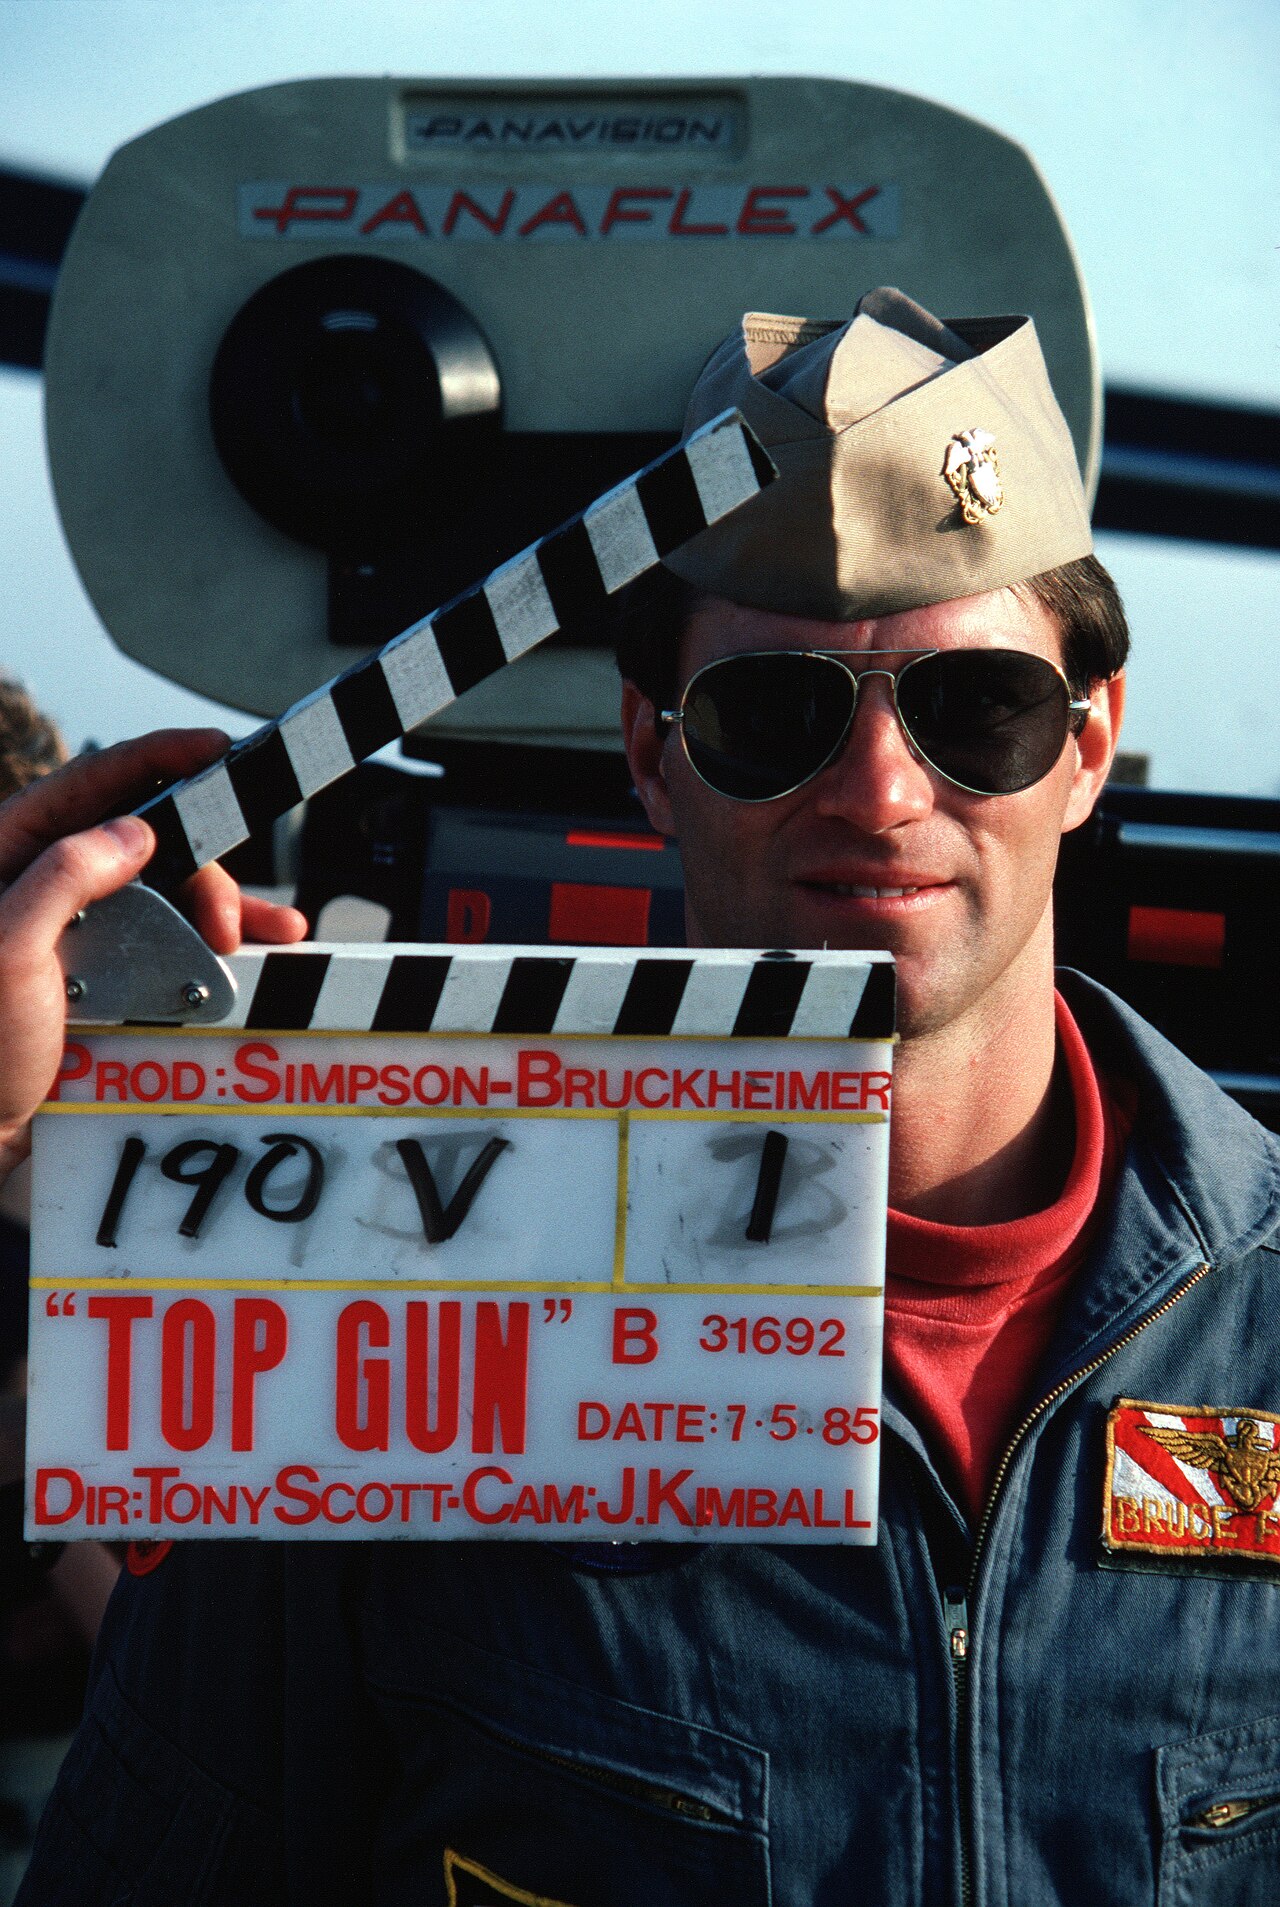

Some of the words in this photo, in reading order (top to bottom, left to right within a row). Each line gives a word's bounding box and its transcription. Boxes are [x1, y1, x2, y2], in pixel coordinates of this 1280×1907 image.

[416, 115, 723, 145] PANAVISION
[252, 185, 879, 236] PANAFLEX
[96, 1132, 326, 1249] 190
[395, 1136, 512, 1245] V
[612, 1308, 659, 1365] B
[699, 1315, 847, 1357] 31692
[1117, 1497, 1238, 1539] BRUCE
